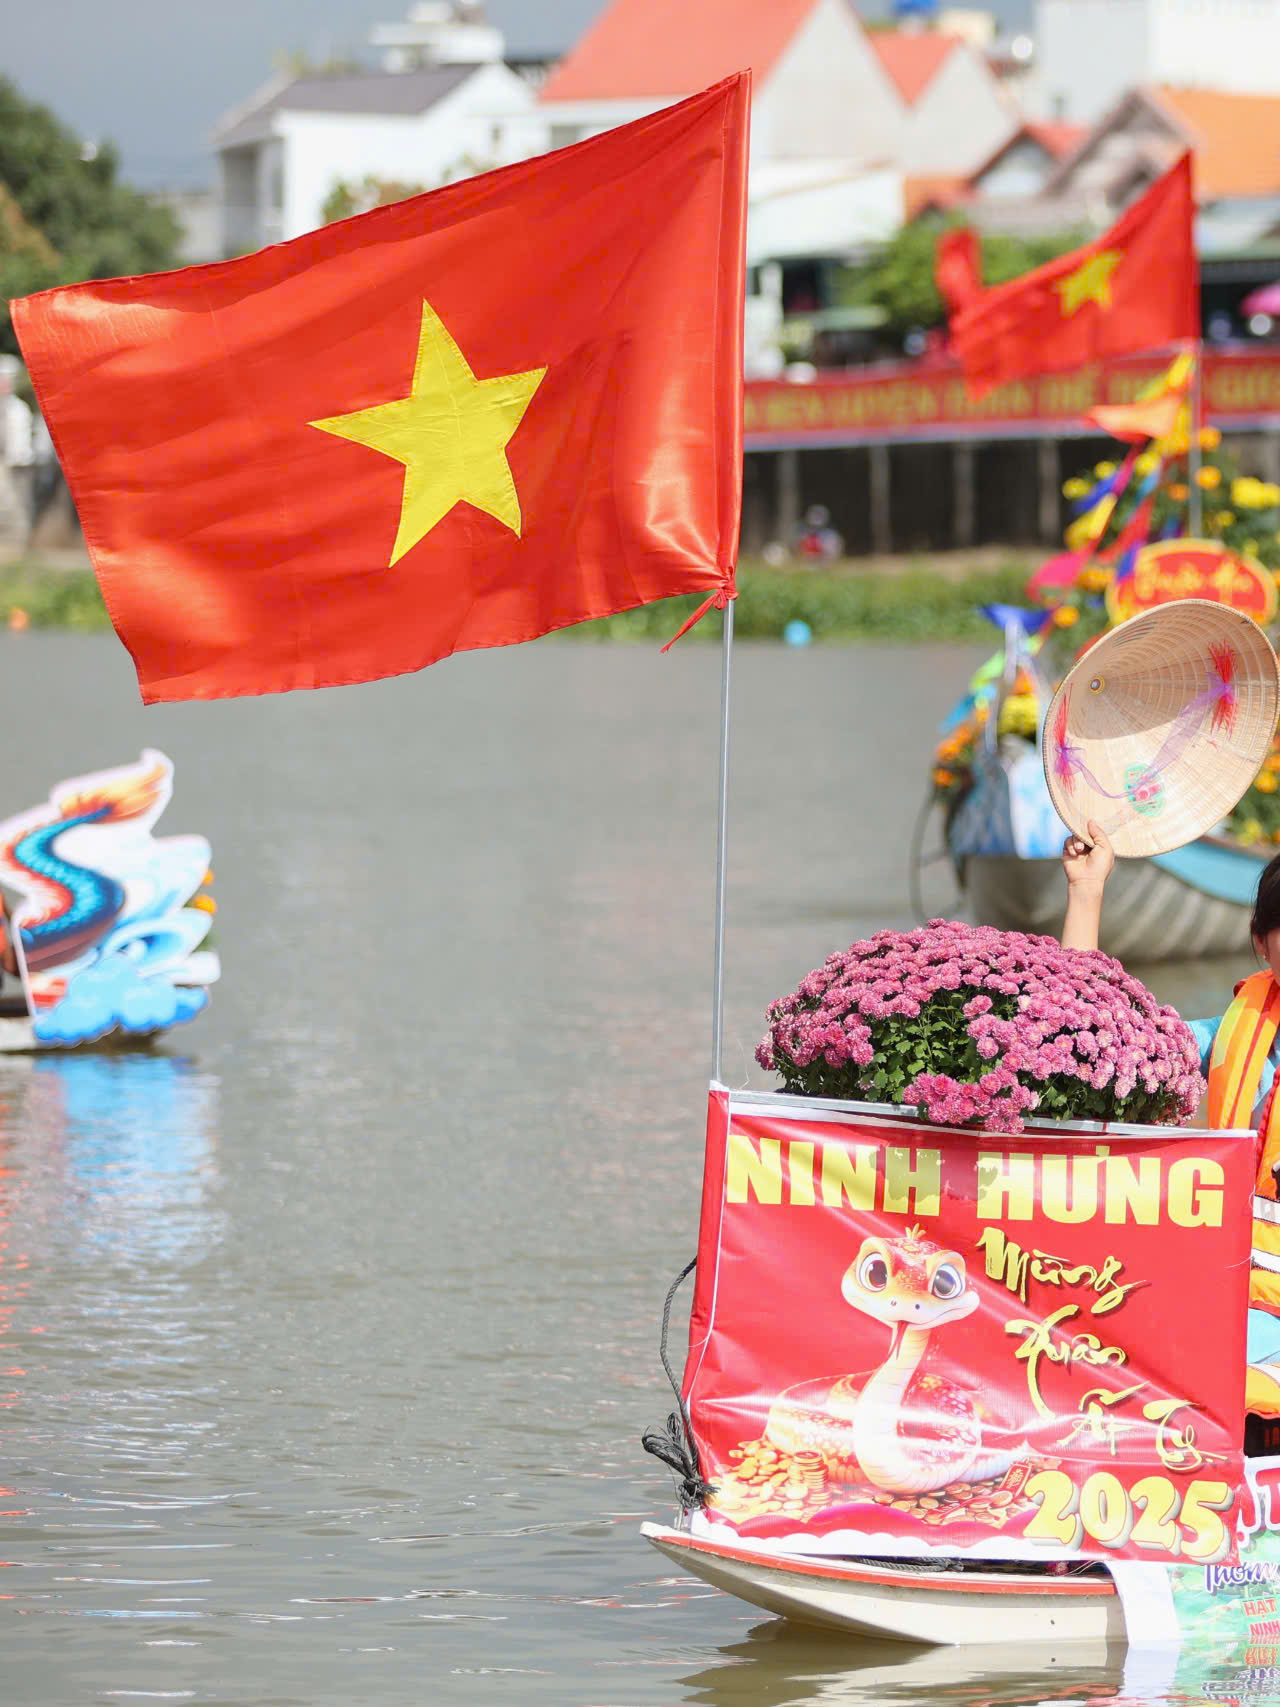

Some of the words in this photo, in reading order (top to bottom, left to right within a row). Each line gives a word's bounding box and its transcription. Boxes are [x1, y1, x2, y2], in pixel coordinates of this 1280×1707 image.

[727, 1135, 941, 1216] NINH
[977, 1146, 1225, 1227] HƯNG
[1004, 1304, 1126, 1419] Xuân
[1023, 1470, 1232, 1560] 2025
[1243, 1598, 1276, 1618] HẠT
[1250, 1620, 1280, 1636] NINH
